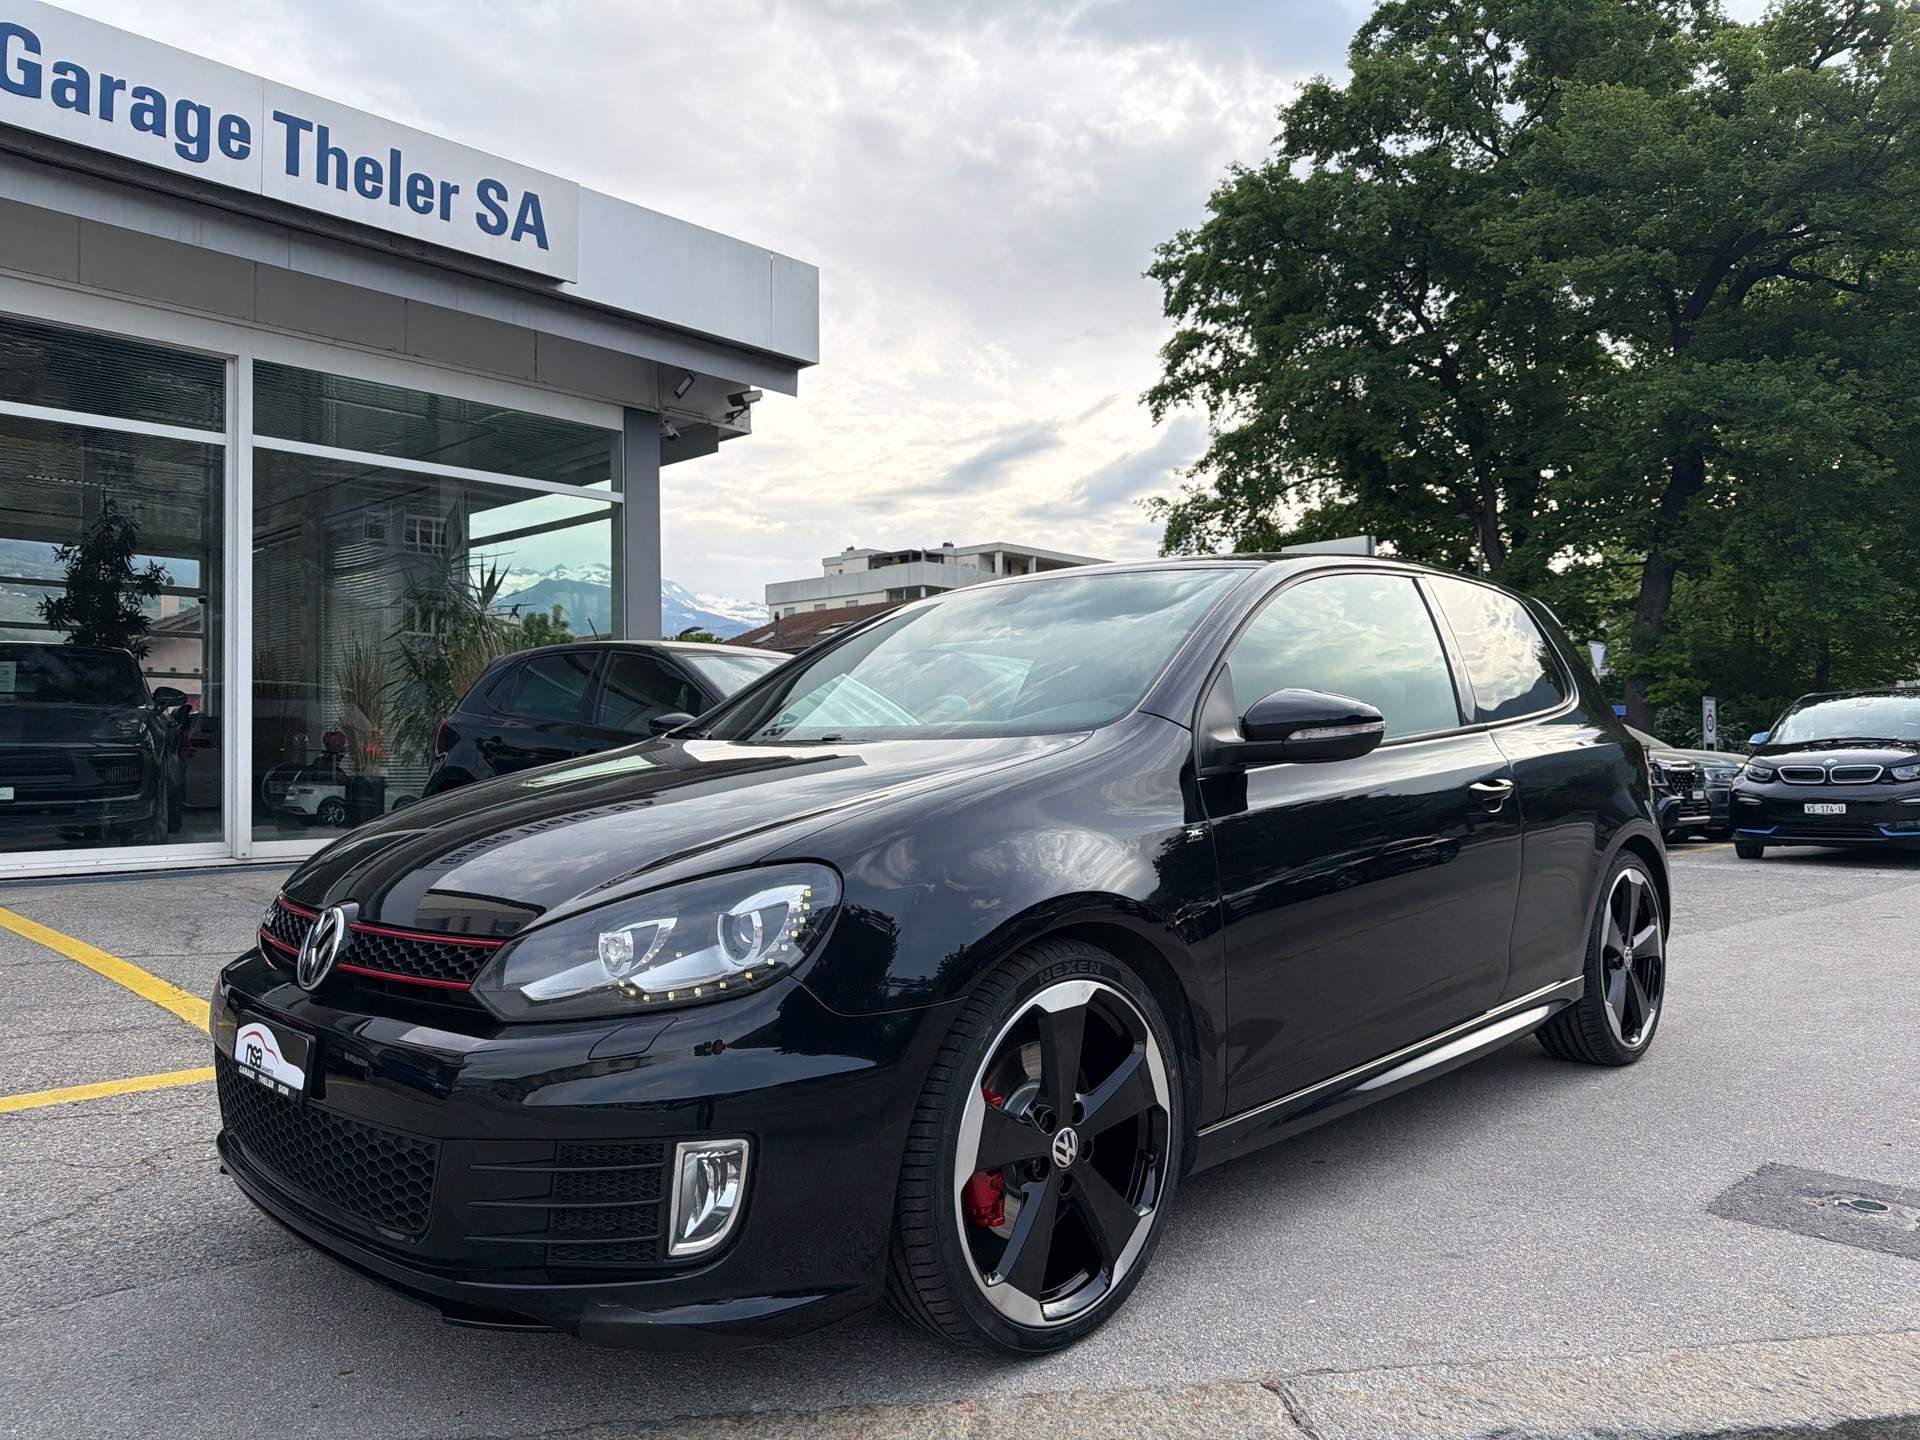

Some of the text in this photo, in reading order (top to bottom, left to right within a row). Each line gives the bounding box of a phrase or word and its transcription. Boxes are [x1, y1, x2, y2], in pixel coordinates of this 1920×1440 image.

[0, 21, 549, 251] Garage Theler SA
[1038, 961, 1101, 985] NEXEN
